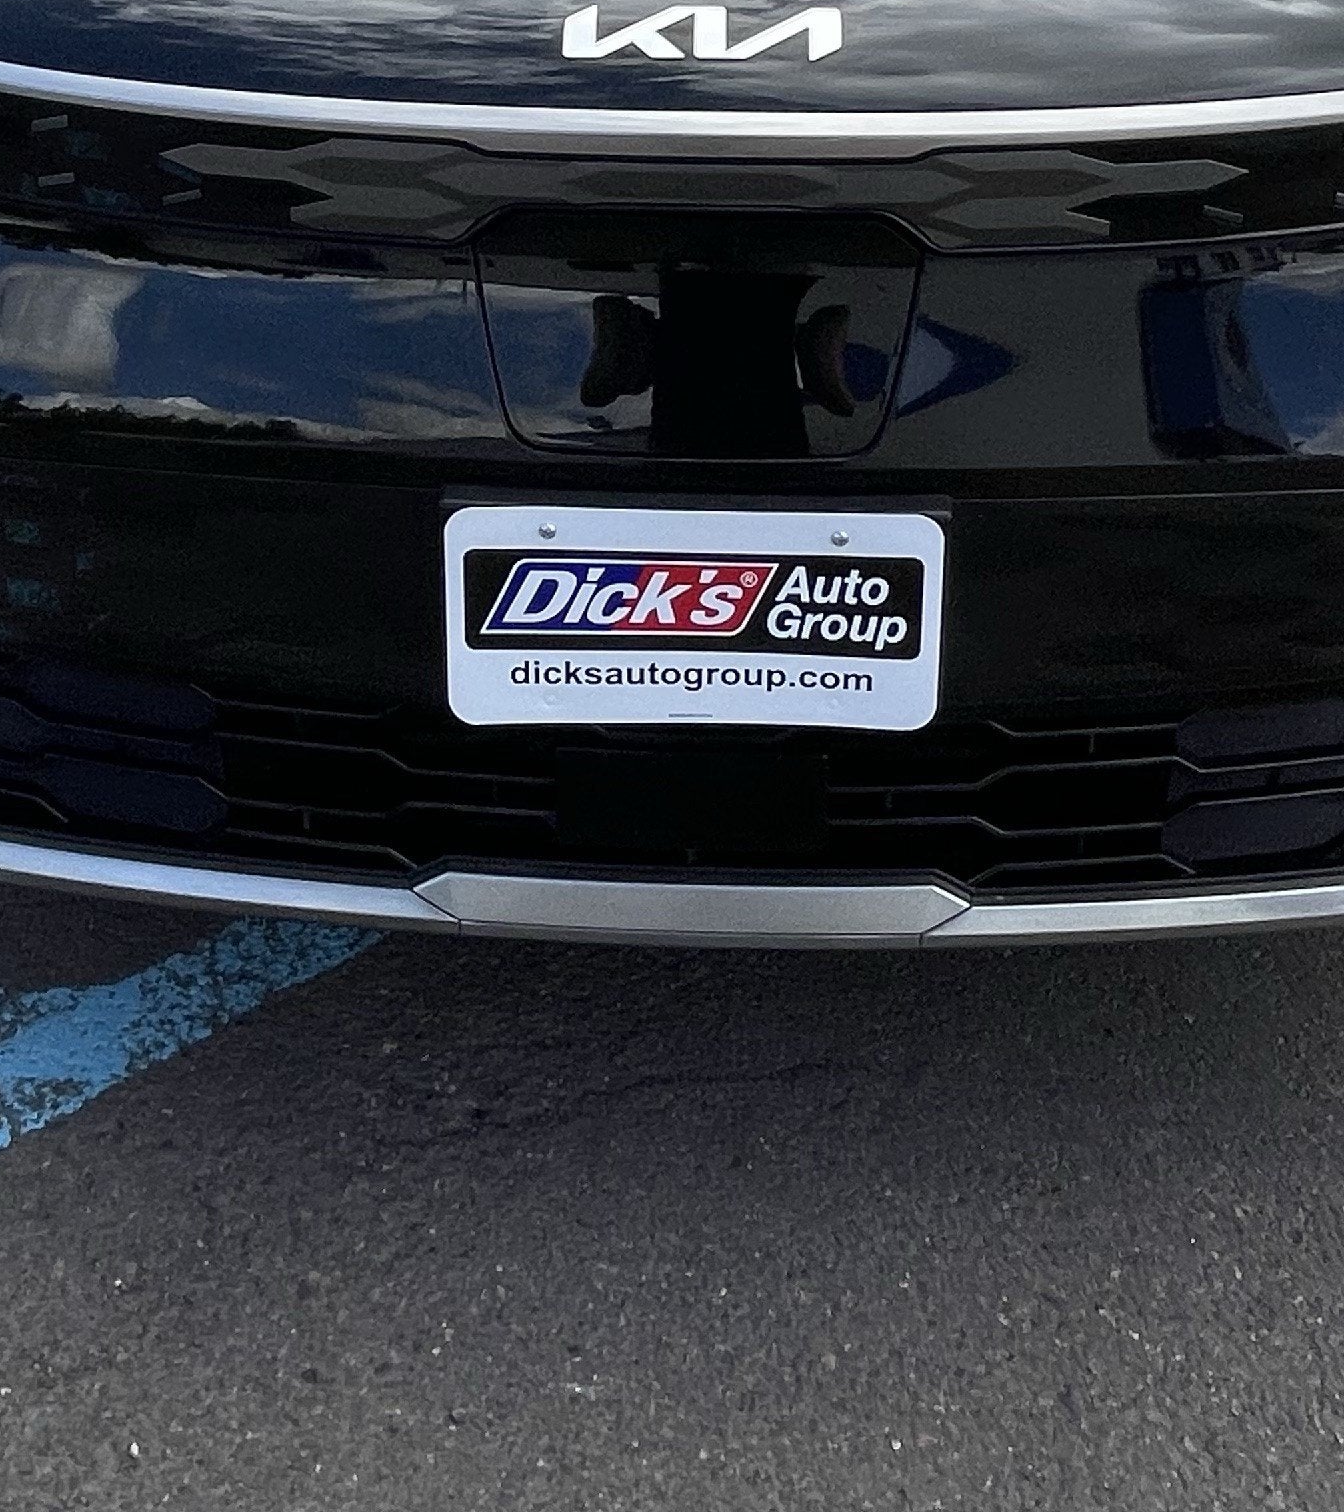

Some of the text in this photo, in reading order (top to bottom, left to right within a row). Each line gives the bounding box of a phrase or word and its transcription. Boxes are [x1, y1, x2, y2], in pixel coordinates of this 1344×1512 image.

[776, 566, 889, 606] Auto
[766, 603, 908, 651] Group
[510, 660, 873, 692] dicksautogroup.com
